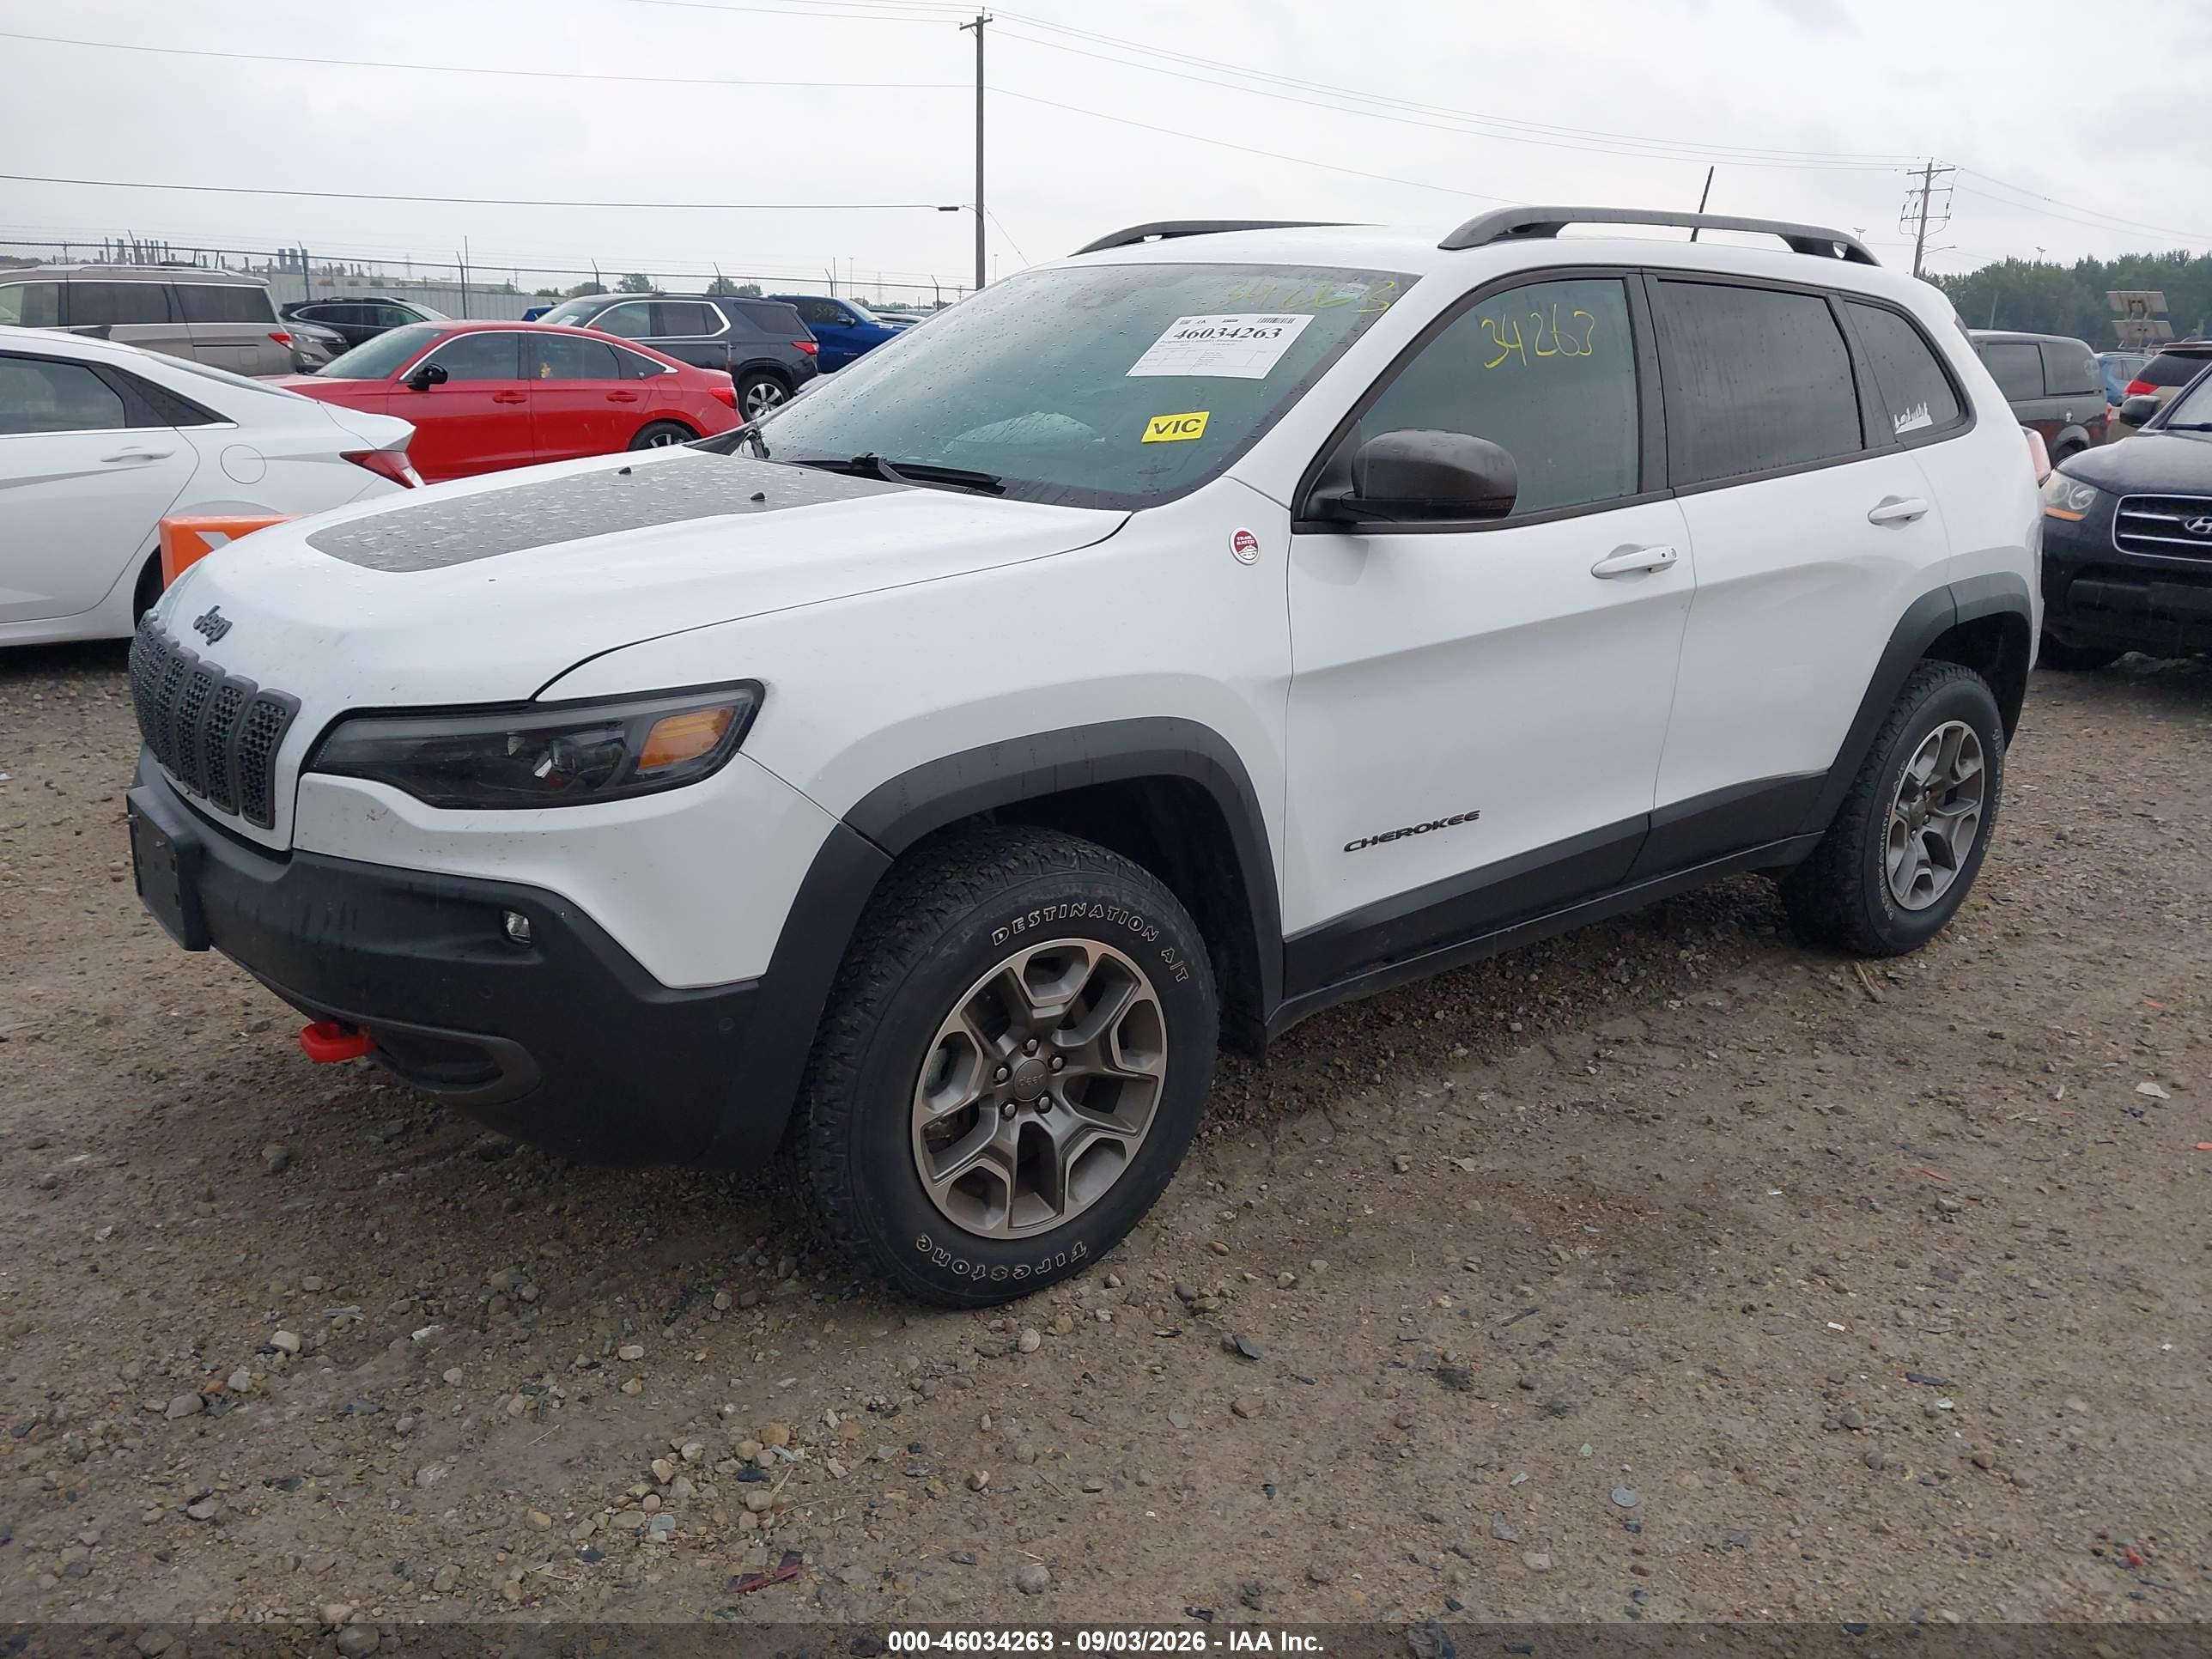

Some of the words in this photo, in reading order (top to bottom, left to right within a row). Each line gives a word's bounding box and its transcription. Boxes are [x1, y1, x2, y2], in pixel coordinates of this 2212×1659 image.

[1173, 327, 1283, 340] 46034263
[1481, 303, 1595, 369] 34263
[1153, 418, 1201, 434] VIC
[193, 605, 233, 646] Jeep
[1344, 811, 1481, 852] CHEROKEE
[991, 902, 1159, 946] DESTINATION
[1161, 947, 1188, 982] A/T
[915, 1233, 1088, 1281] Firestone
